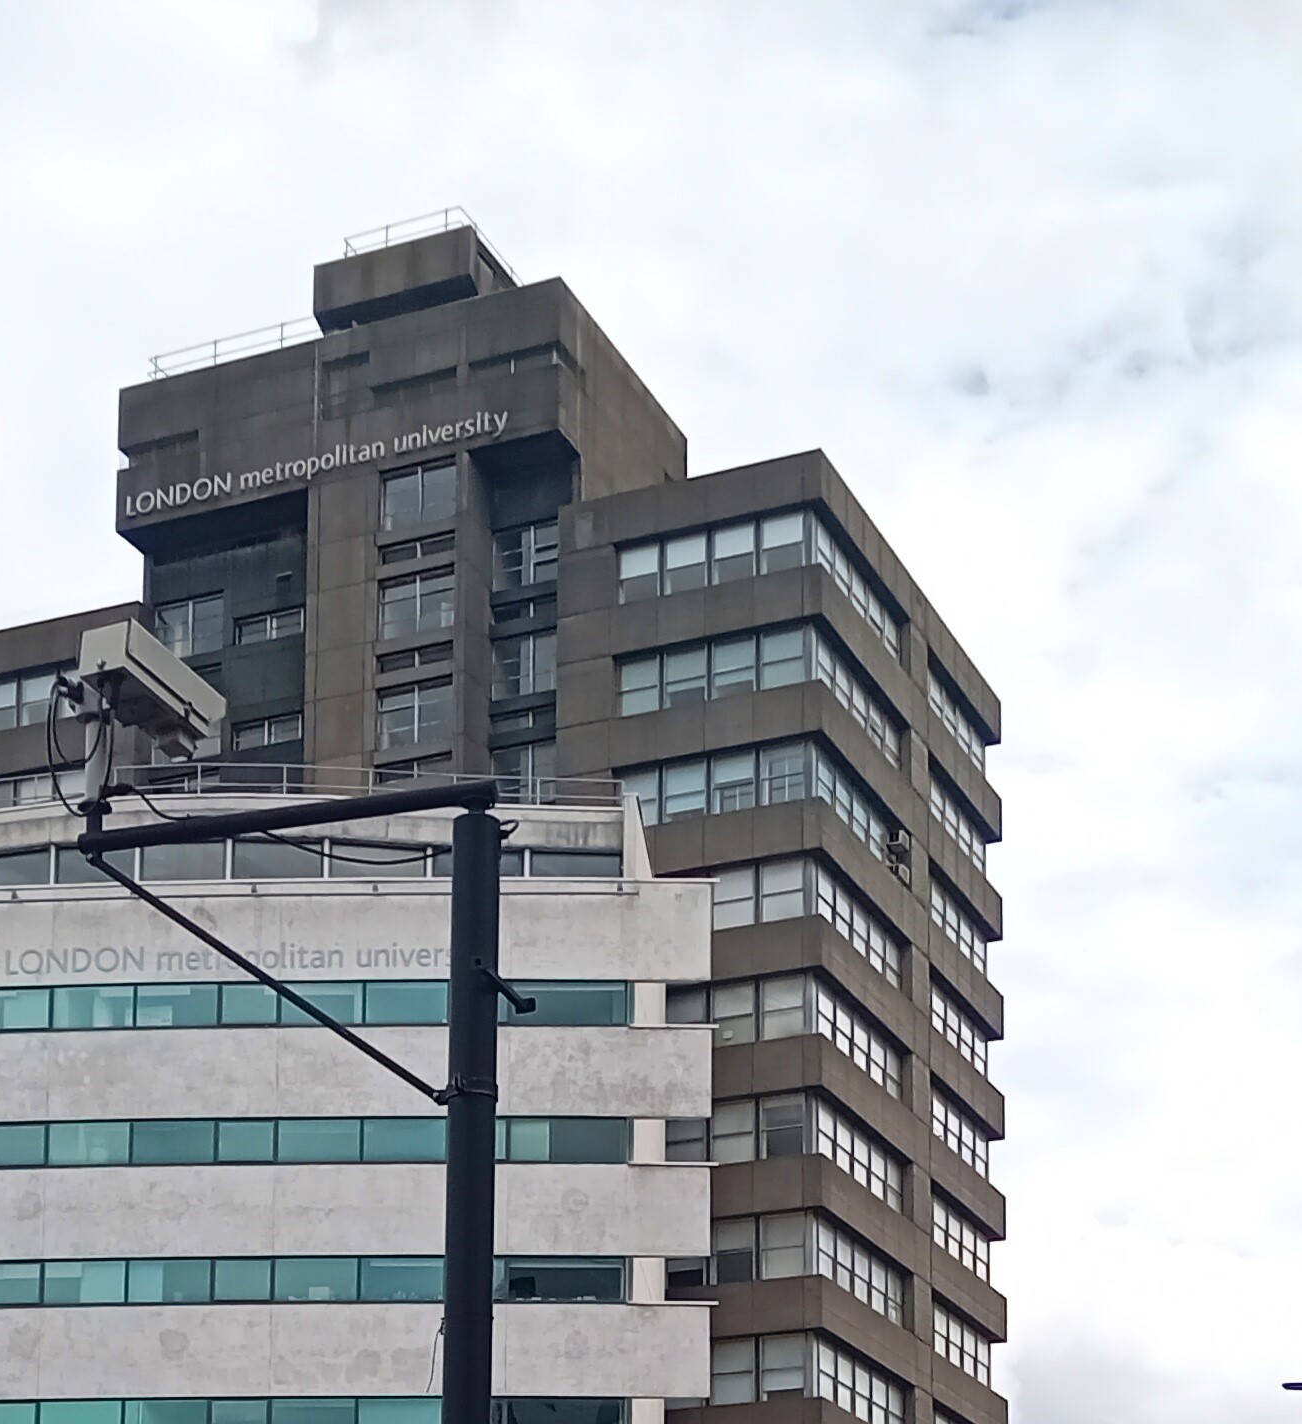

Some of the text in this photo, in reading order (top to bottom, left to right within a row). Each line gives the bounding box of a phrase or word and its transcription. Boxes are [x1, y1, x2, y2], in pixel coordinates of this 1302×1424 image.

[125, 410, 508, 517] LONDON metropolitan university
[5, 946, 145, 976] LONDON
